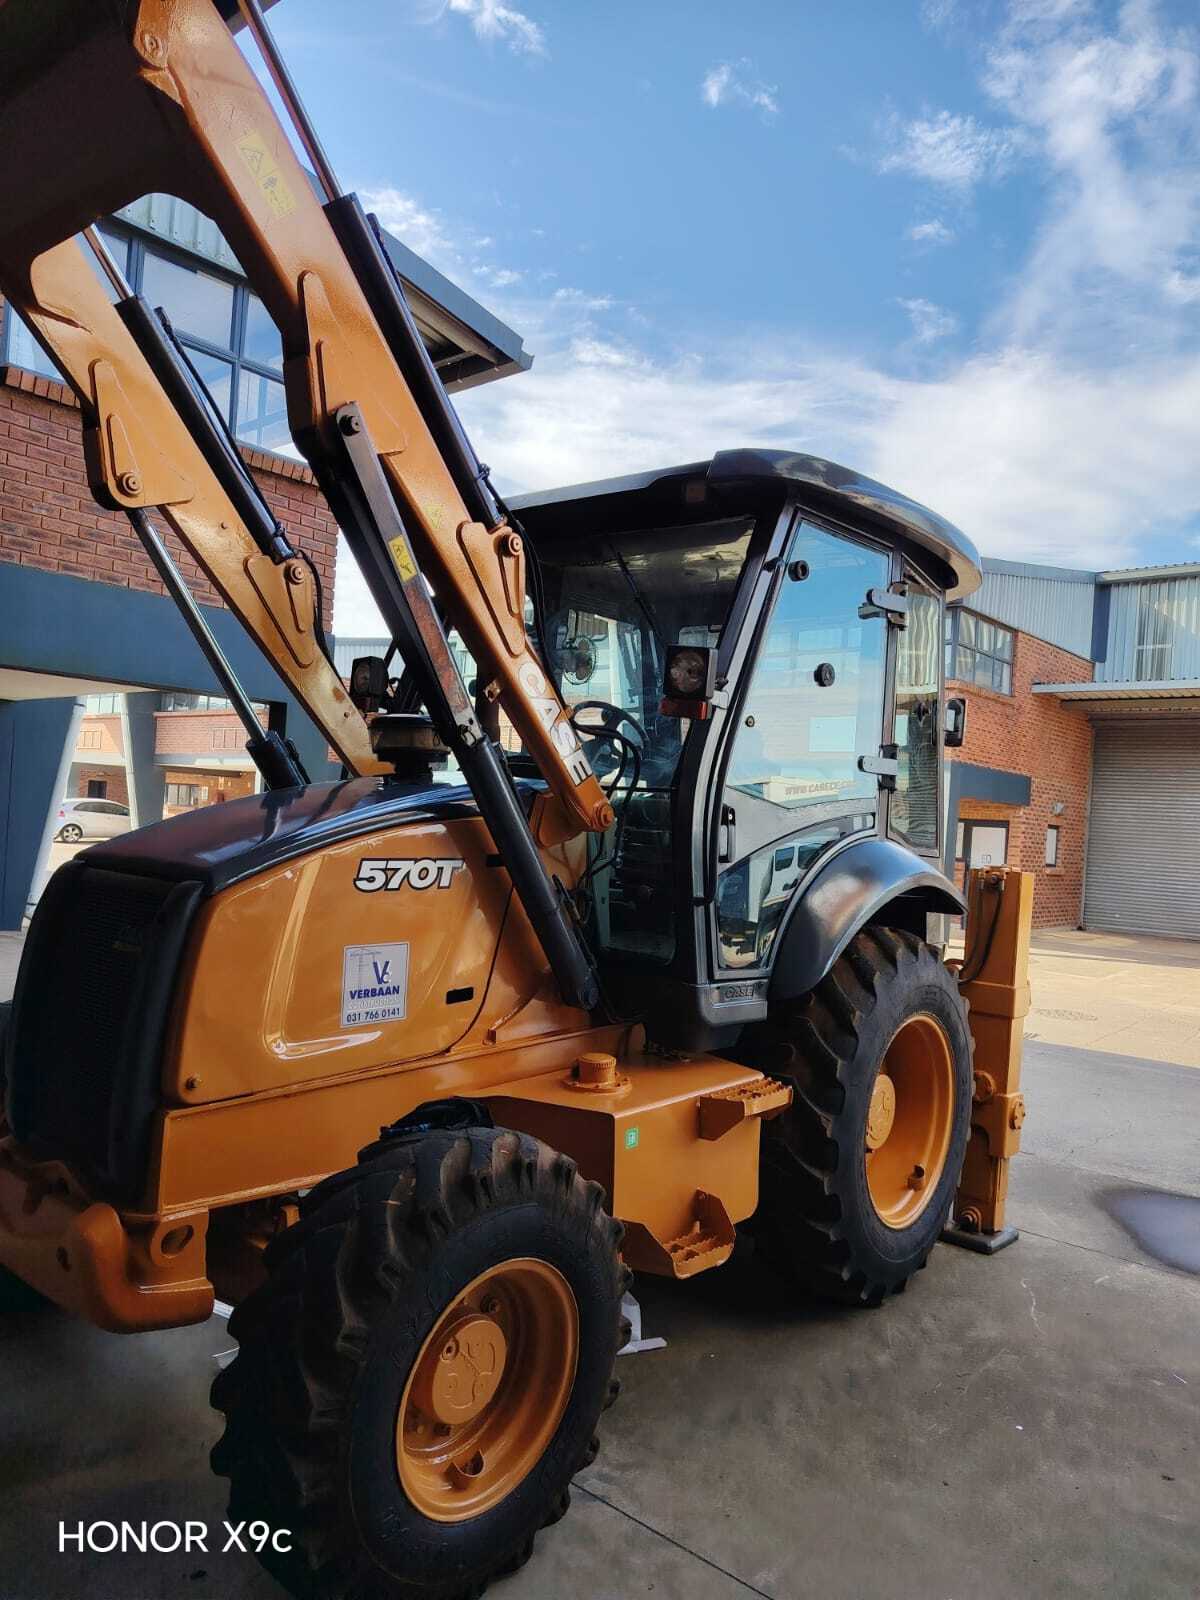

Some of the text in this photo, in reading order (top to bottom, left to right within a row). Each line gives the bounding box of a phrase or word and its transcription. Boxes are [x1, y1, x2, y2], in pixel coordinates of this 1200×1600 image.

[518, 661, 593, 786] CASE
[353, 857, 465, 893] 570T
[349, 985, 400, 1000] VERBAAN
[725, 984, 755, 999] CASE
[346, 1007, 400, 1023] 031 766 0141
